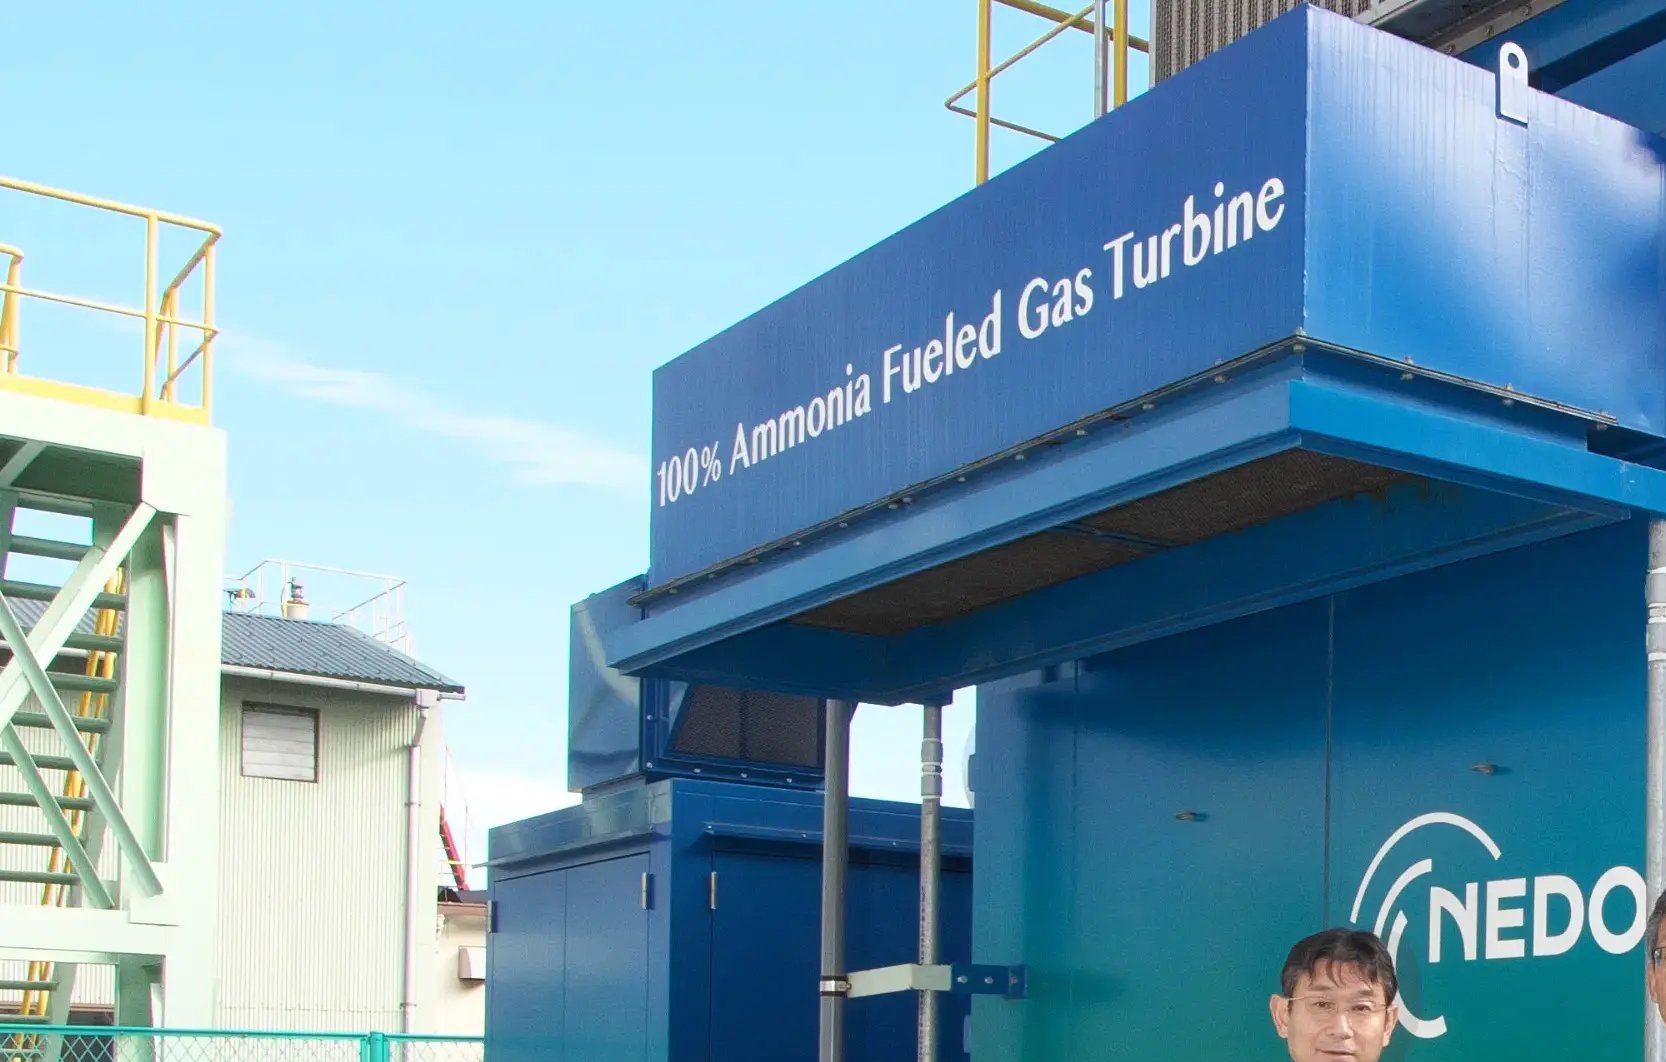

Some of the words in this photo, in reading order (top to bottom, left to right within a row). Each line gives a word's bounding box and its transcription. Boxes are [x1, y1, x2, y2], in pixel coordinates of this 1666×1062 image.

[657, 441, 722, 507] 100%
[729, 363, 872, 475] Ammonia
[882, 290, 1002, 404] Fueled
[1017, 267, 1094, 339] Gas
[1103, 176, 1286, 301] Turbine
[1428, 865, 1648, 963] NEDO
